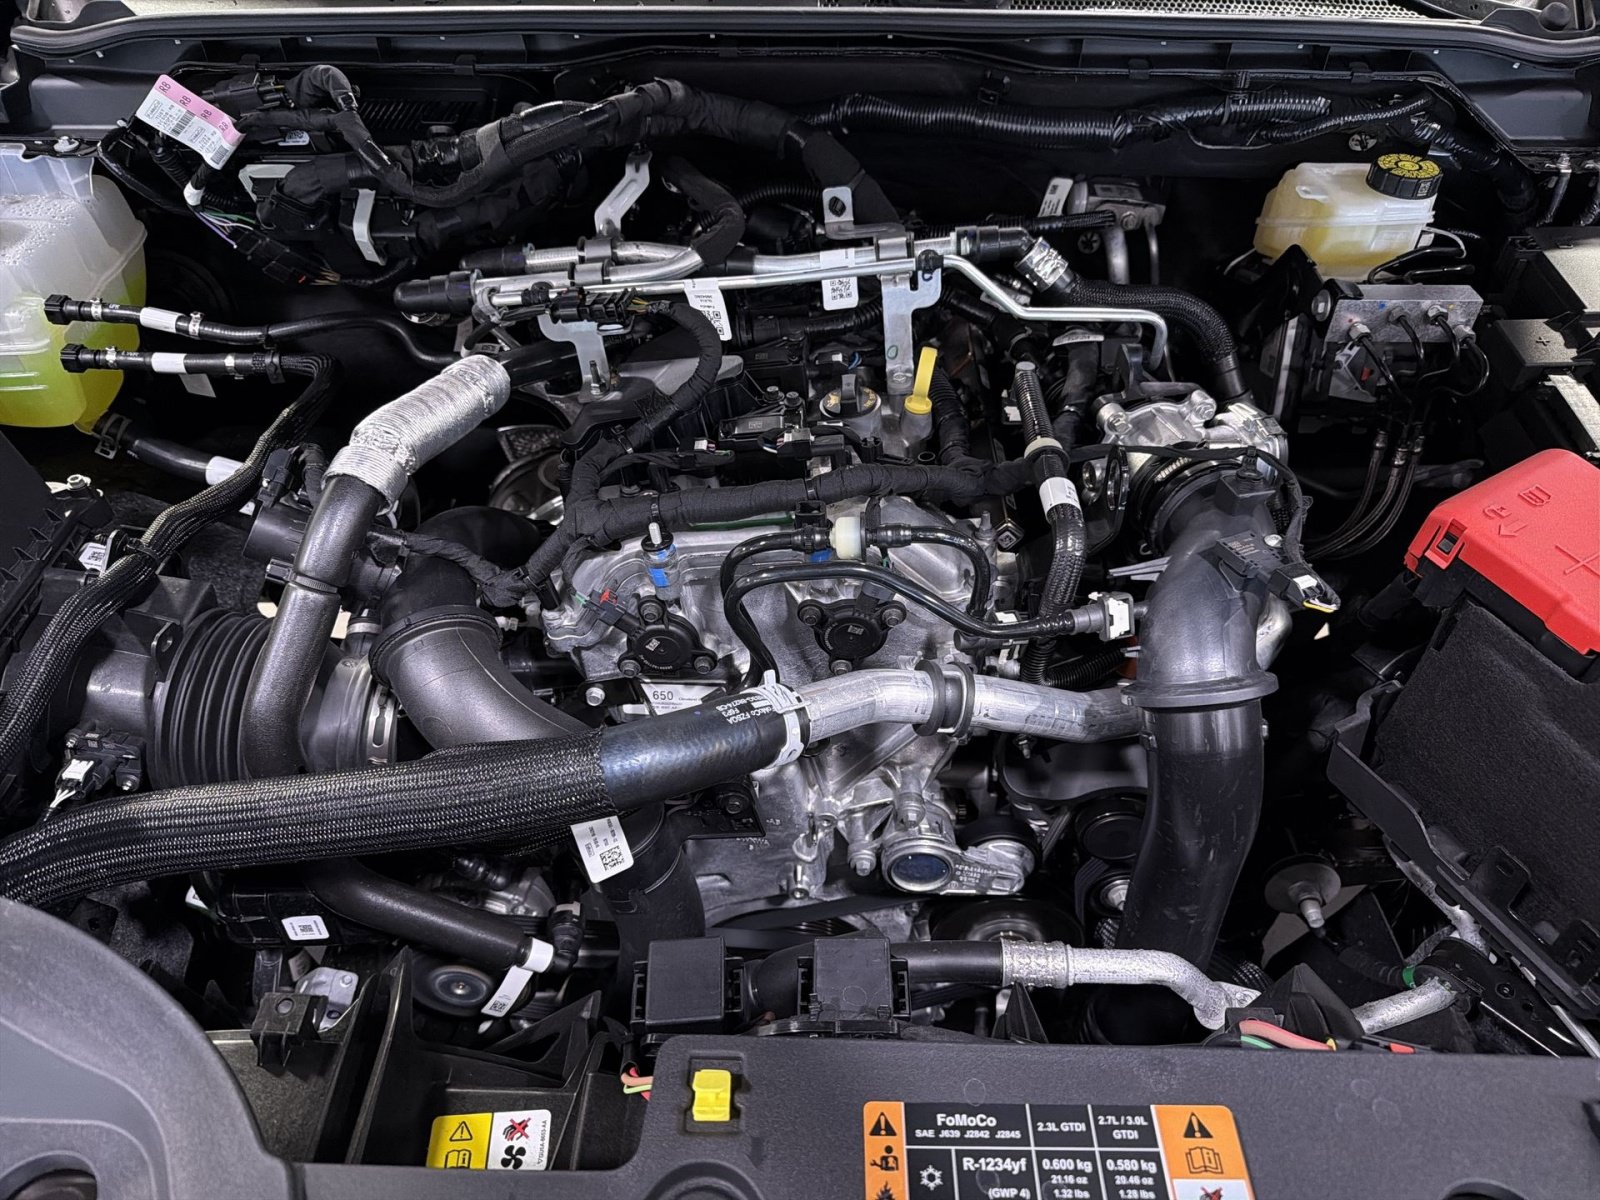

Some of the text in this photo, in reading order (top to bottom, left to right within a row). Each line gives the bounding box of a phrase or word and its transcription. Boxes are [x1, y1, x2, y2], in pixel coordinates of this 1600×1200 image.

[159, 81, 171, 93] RB
[179, 95, 192, 107] RB
[201, 109, 212, 119] RB
[219, 121, 229, 132] RB
[652, 690, 674, 700] 650
[936, 1114, 997, 1127] FoMoCo
[1097, 1116, 1119, 1125] 2.7L
[1126, 1116, 1148, 1125] 3.0L
[1037, 1122, 1086, 1132] 2.3L GTDI
[915, 1129, 935, 1138] SAE
[964, 1130, 990, 1138] J2842
[994, 1130, 1021, 1139] J2845
[1112, 1130, 1138, 1139] GTDI
[962, 1157, 1026, 1174] R-1234yf
[1042, 1158, 1092, 1172] 0.600 kg
[1106, 1159, 1157, 1173] 0.580 kg
[1051, 1175, 1075, 1184] 21.16
[988, 1188, 1031, 1200] (GWP 4)
[1053, 1189, 1090, 1199] 1.32 lbs
[1140, 1190, 1155, 1199] lbs
